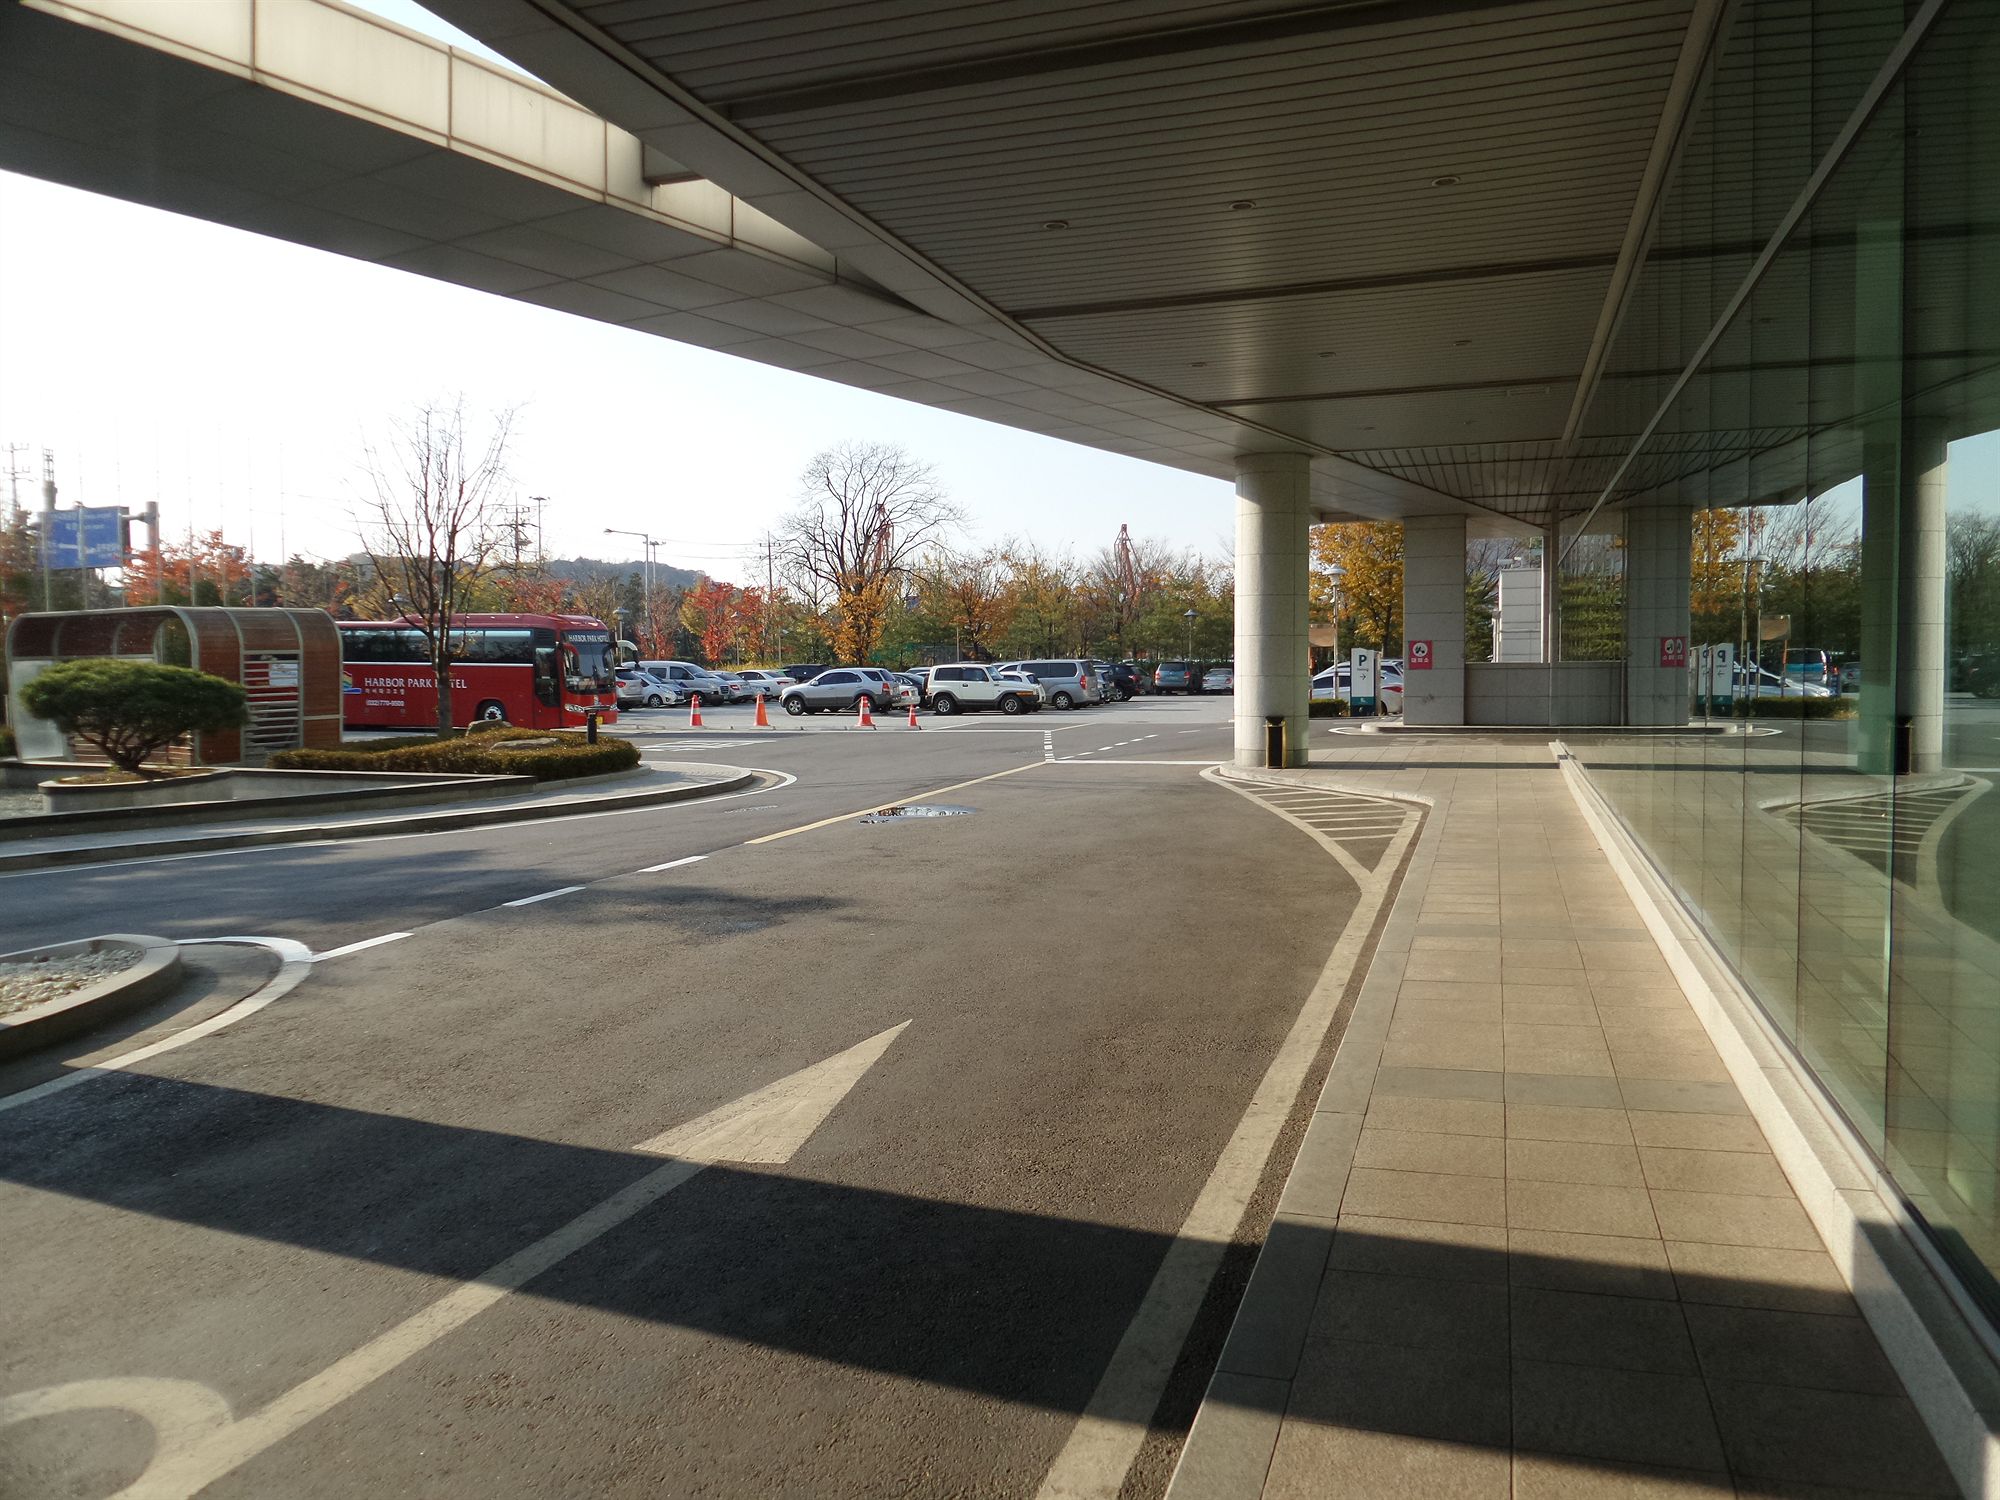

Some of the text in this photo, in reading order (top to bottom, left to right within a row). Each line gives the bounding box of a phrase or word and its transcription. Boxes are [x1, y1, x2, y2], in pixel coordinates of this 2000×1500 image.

[1359, 655, 1367, 666] P
[364, 677, 405, 687] HARBOR
[408, 678, 432, 688] PARK
